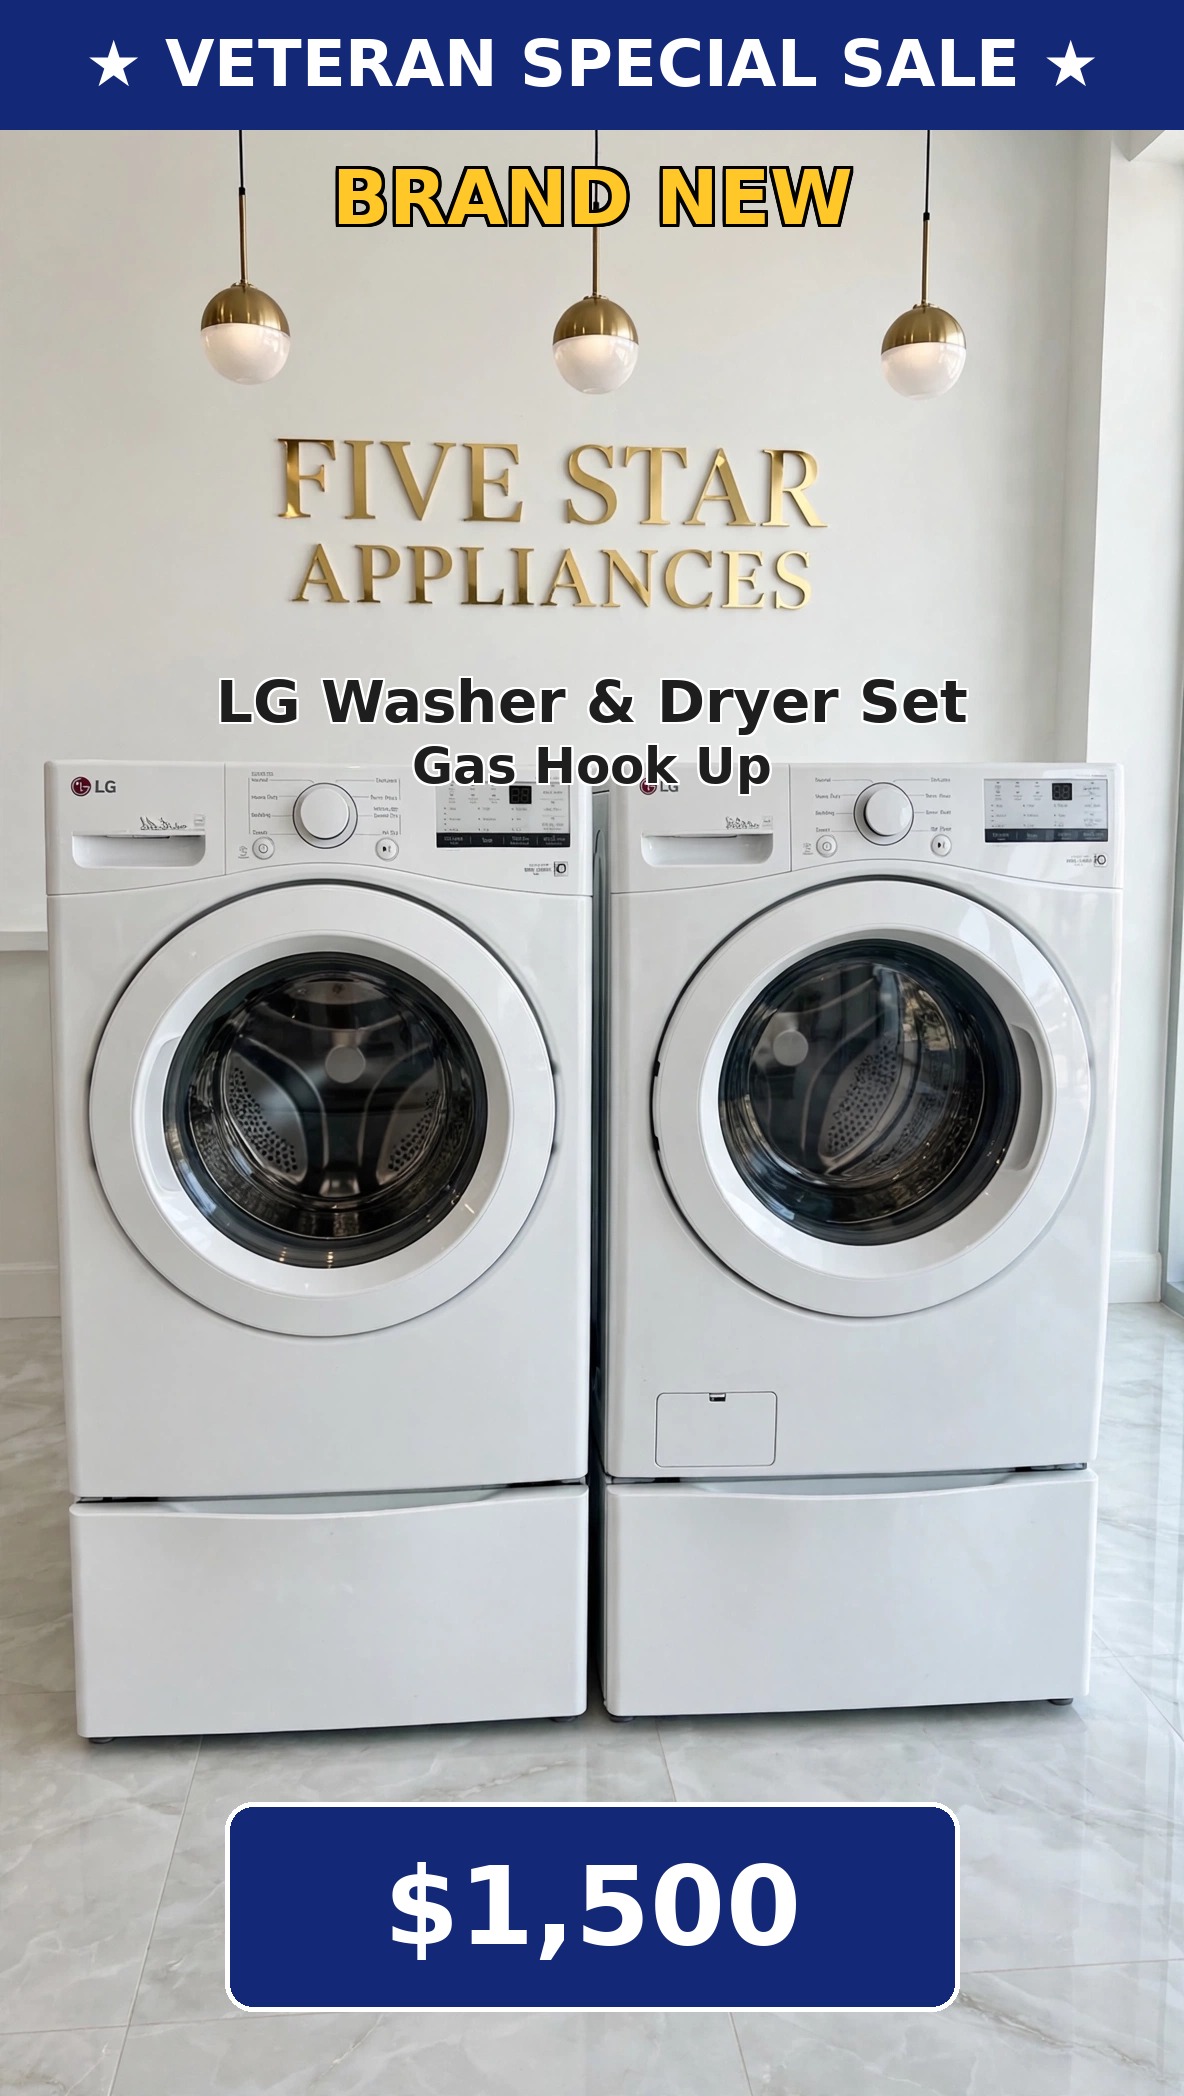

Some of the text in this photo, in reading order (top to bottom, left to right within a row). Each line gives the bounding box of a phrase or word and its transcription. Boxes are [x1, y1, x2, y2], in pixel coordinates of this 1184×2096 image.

[277, 437, 828, 529] FIVE STAR
[292, 543, 812, 611] APPLIANCES
[95, 780, 117, 793] LG
